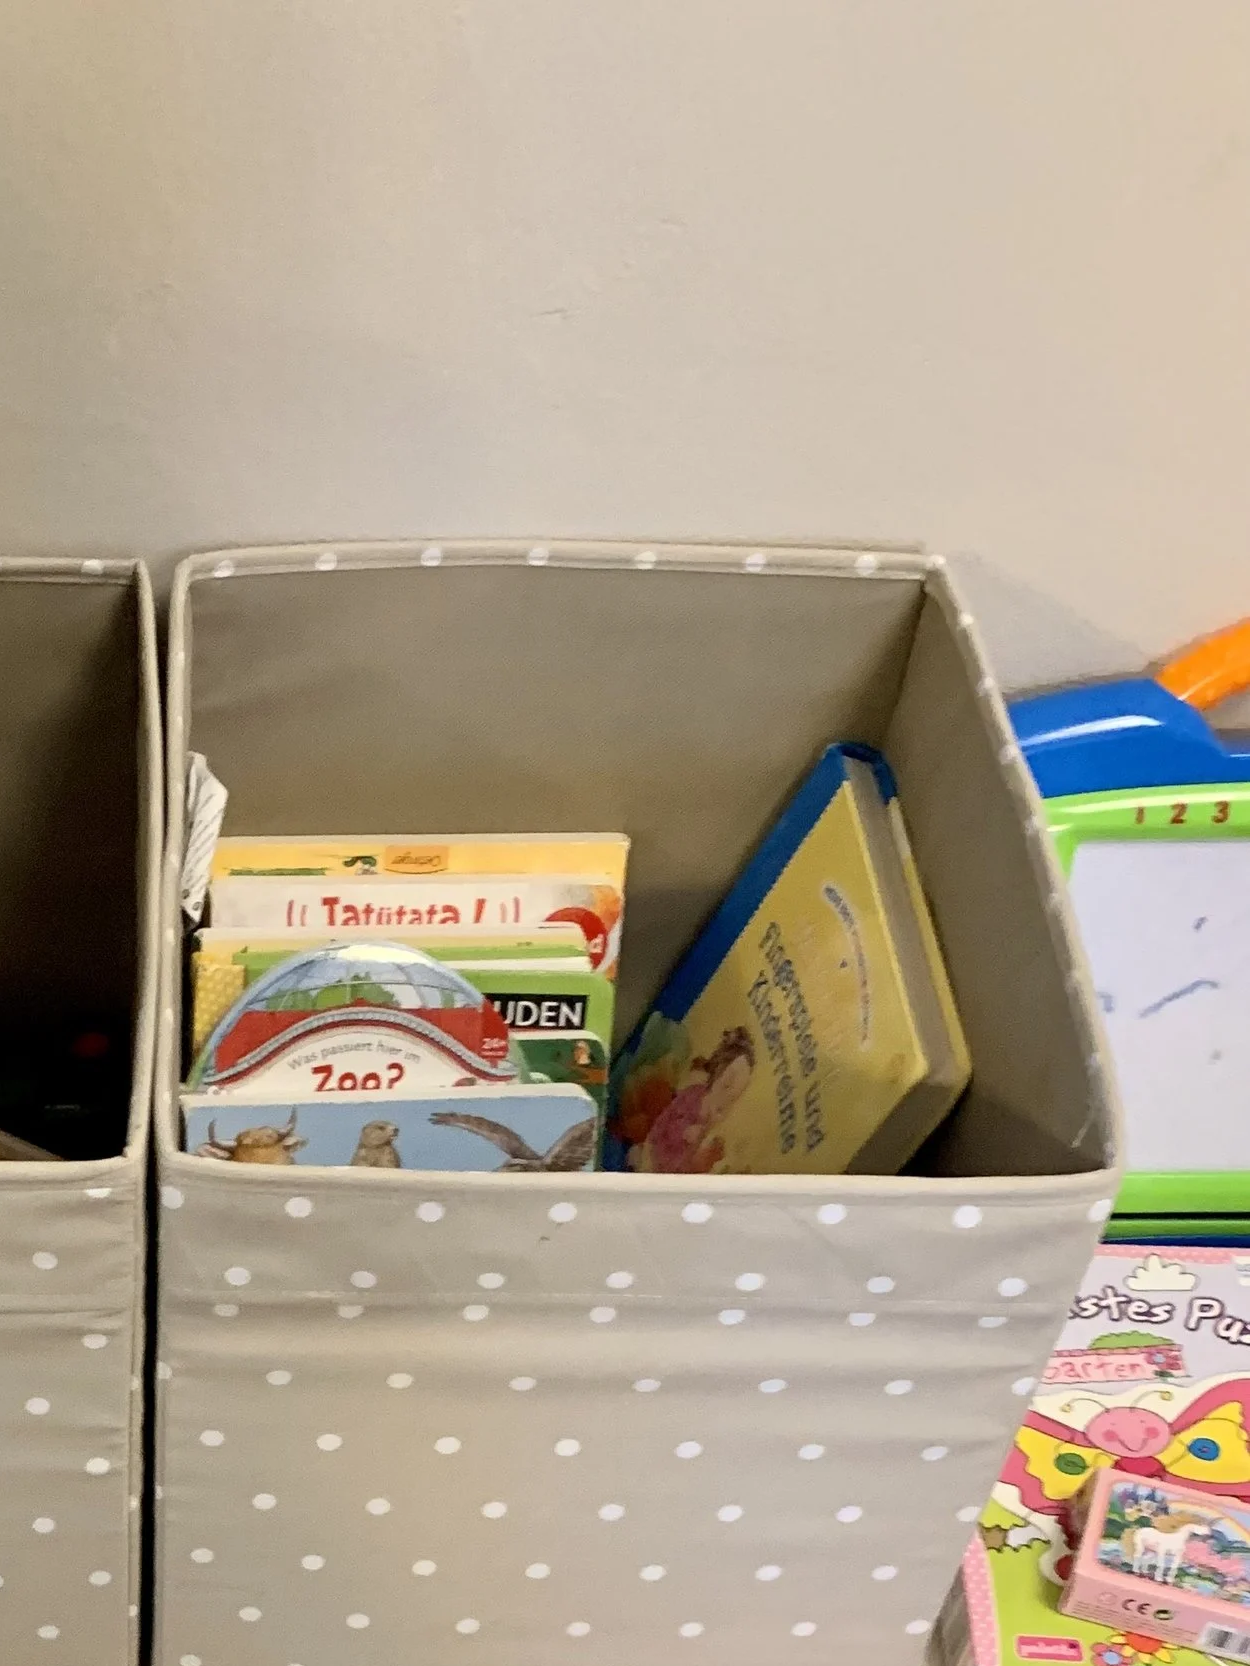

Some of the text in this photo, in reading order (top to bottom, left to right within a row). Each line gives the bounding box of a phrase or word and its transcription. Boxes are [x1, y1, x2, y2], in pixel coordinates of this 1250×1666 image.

[1135, 801, 1229, 824] 1 2 3
[493, 1000, 584, 1028] UDEN
[311, 1062, 405, 1092] Zoo?
[1069, 1285, 1176, 1324] stes
